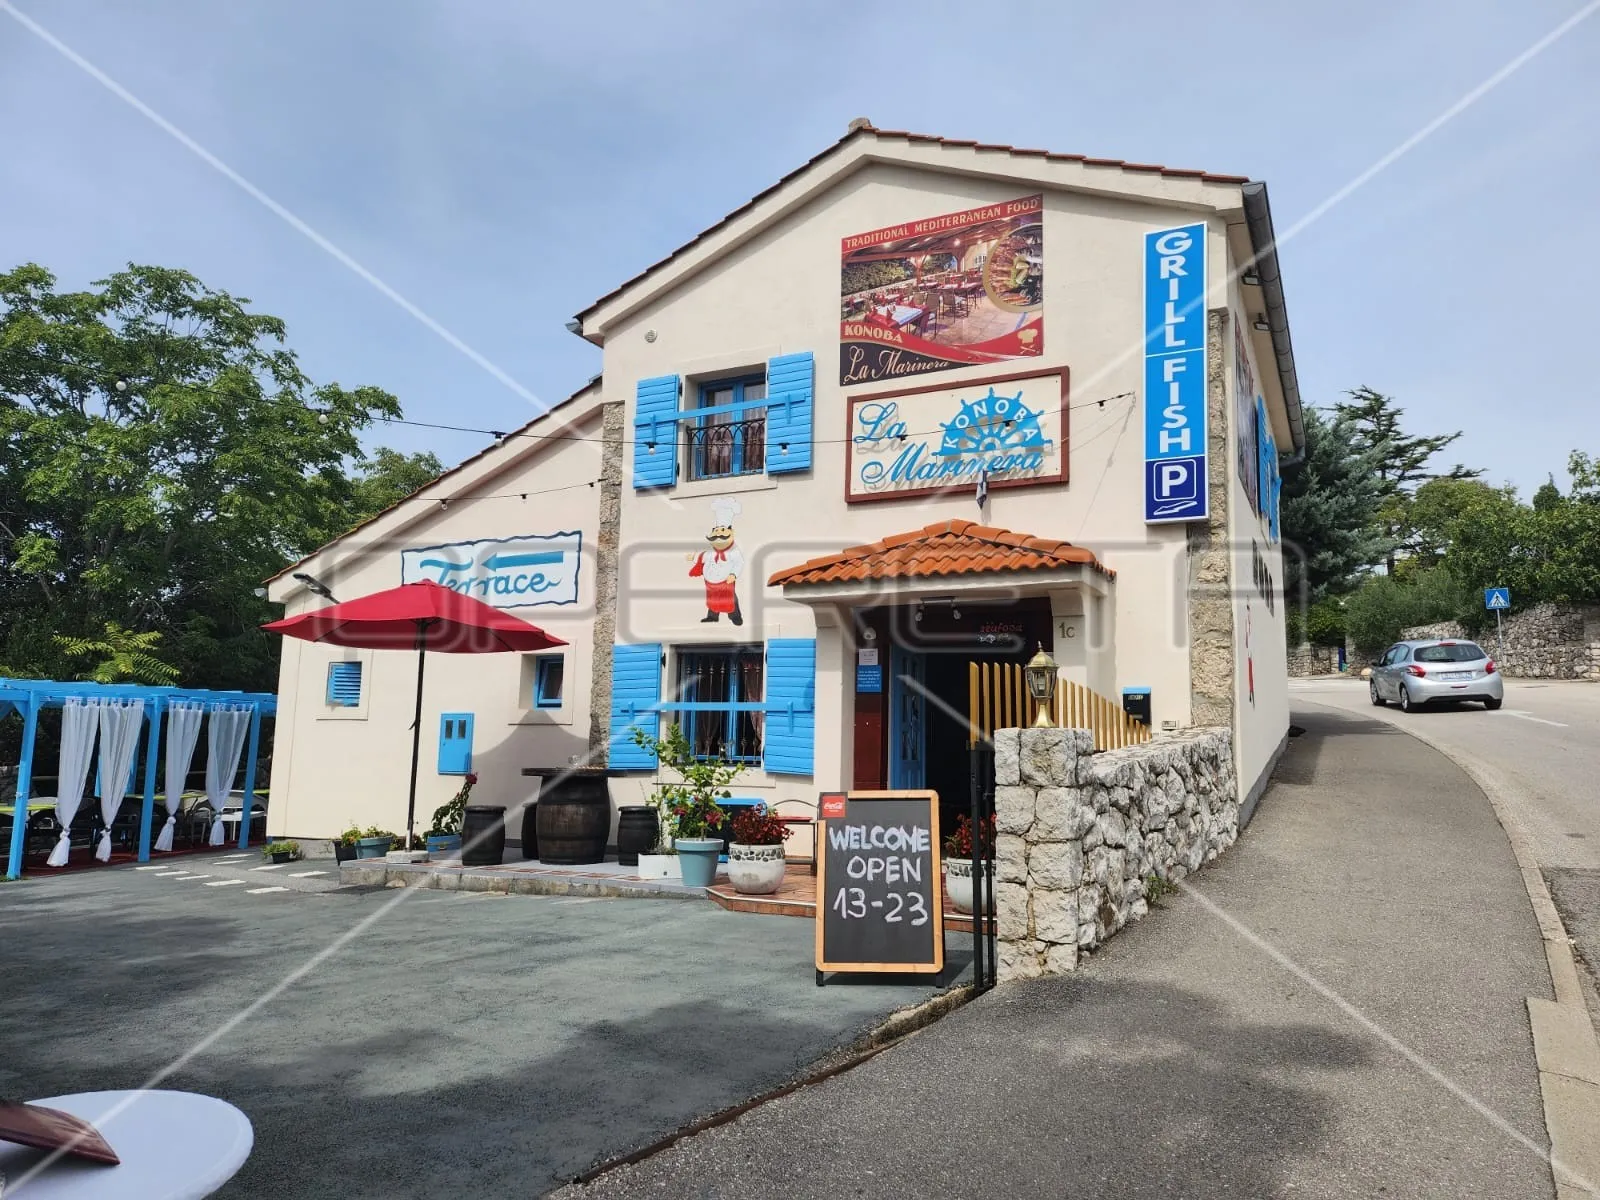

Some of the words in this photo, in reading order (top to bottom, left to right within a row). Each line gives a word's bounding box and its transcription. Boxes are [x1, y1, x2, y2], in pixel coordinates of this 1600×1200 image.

[846, 225, 909, 248] TRADITIONAL
[914, 206, 1001, 233] MEDITERRANEAN
[1007, 198, 1039, 214] FOOD
[1155, 231, 1193, 348] GRILL
[844, 325, 904, 344] KONOBA
[843, 345, 869, 384] La
[871, 349, 949, 378] Marinera
[853, 402, 906, 444] La
[944, 400, 1039, 448] KONOBA
[1159, 357, 1191, 453] FISH
[1161, 465, 1188, 497] P
[829, 825, 931, 853] WELCOME
[846, 855, 921, 884] OPEN
